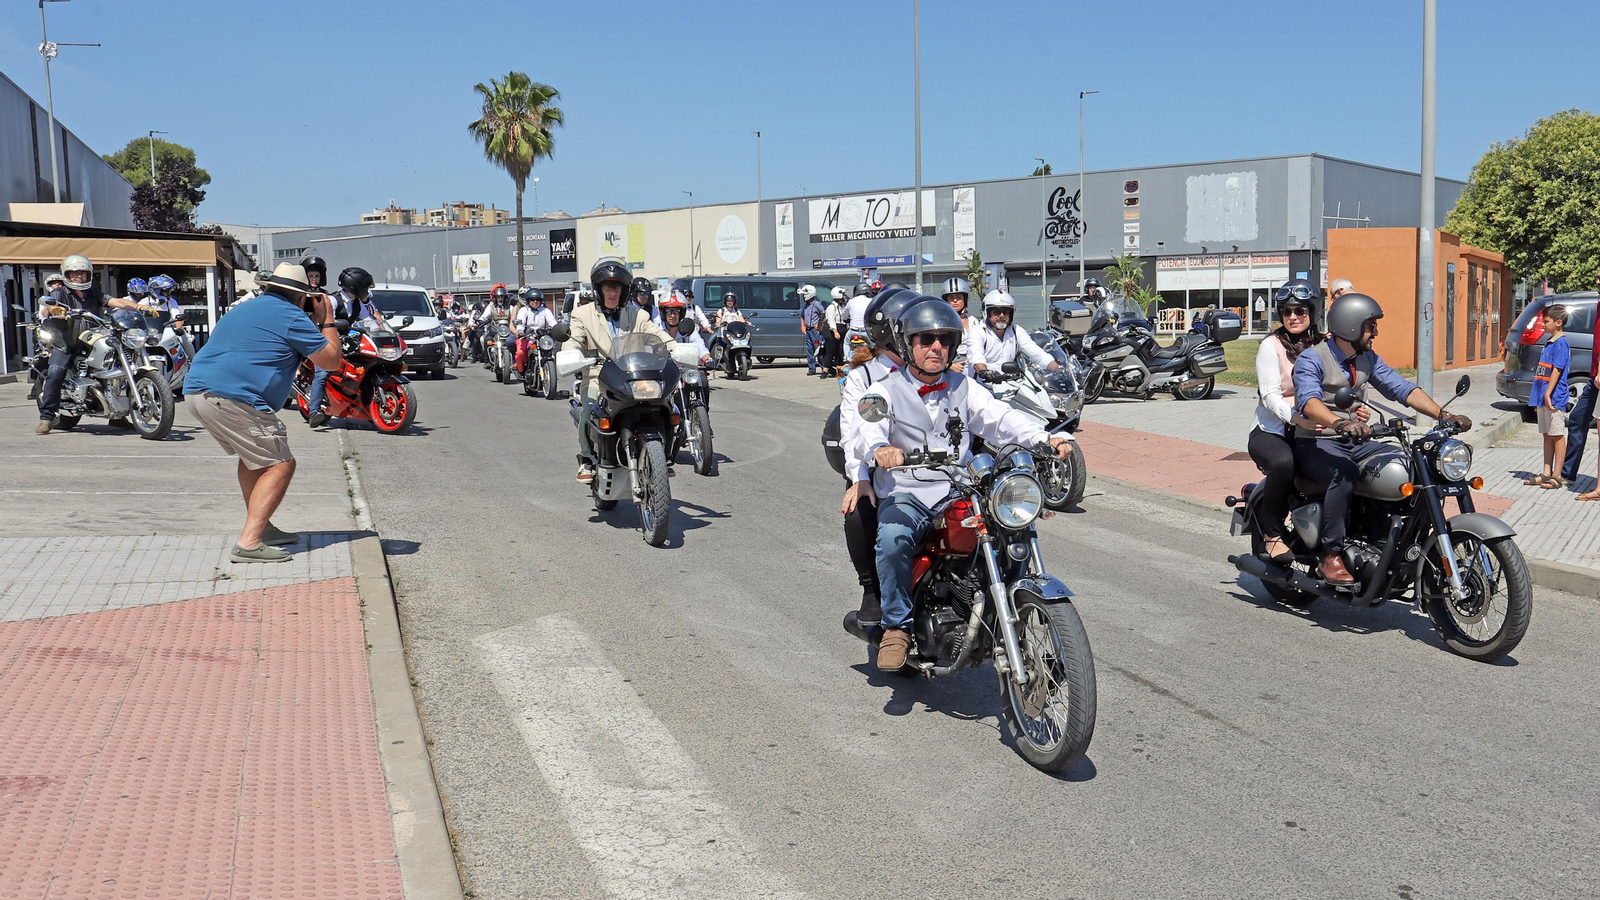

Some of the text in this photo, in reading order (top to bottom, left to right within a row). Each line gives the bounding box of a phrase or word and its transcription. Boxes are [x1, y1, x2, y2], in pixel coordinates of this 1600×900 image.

[1048, 186, 1081, 216] Cool
[526, 233, 546, 241] MONTAÑA
[820, 228, 922, 242] TALLER MECANICO Y VENTA
[551, 242, 567, 252] YAK
[1158, 257, 1186, 268] POTENCIA
[1189, 255, 1218, 267] EQUILIBRIO
[1224, 255, 1248, 265] AGILIDAD
[1160, 322, 1185, 331] STORE
[1536, 365, 1546, 376] ER
